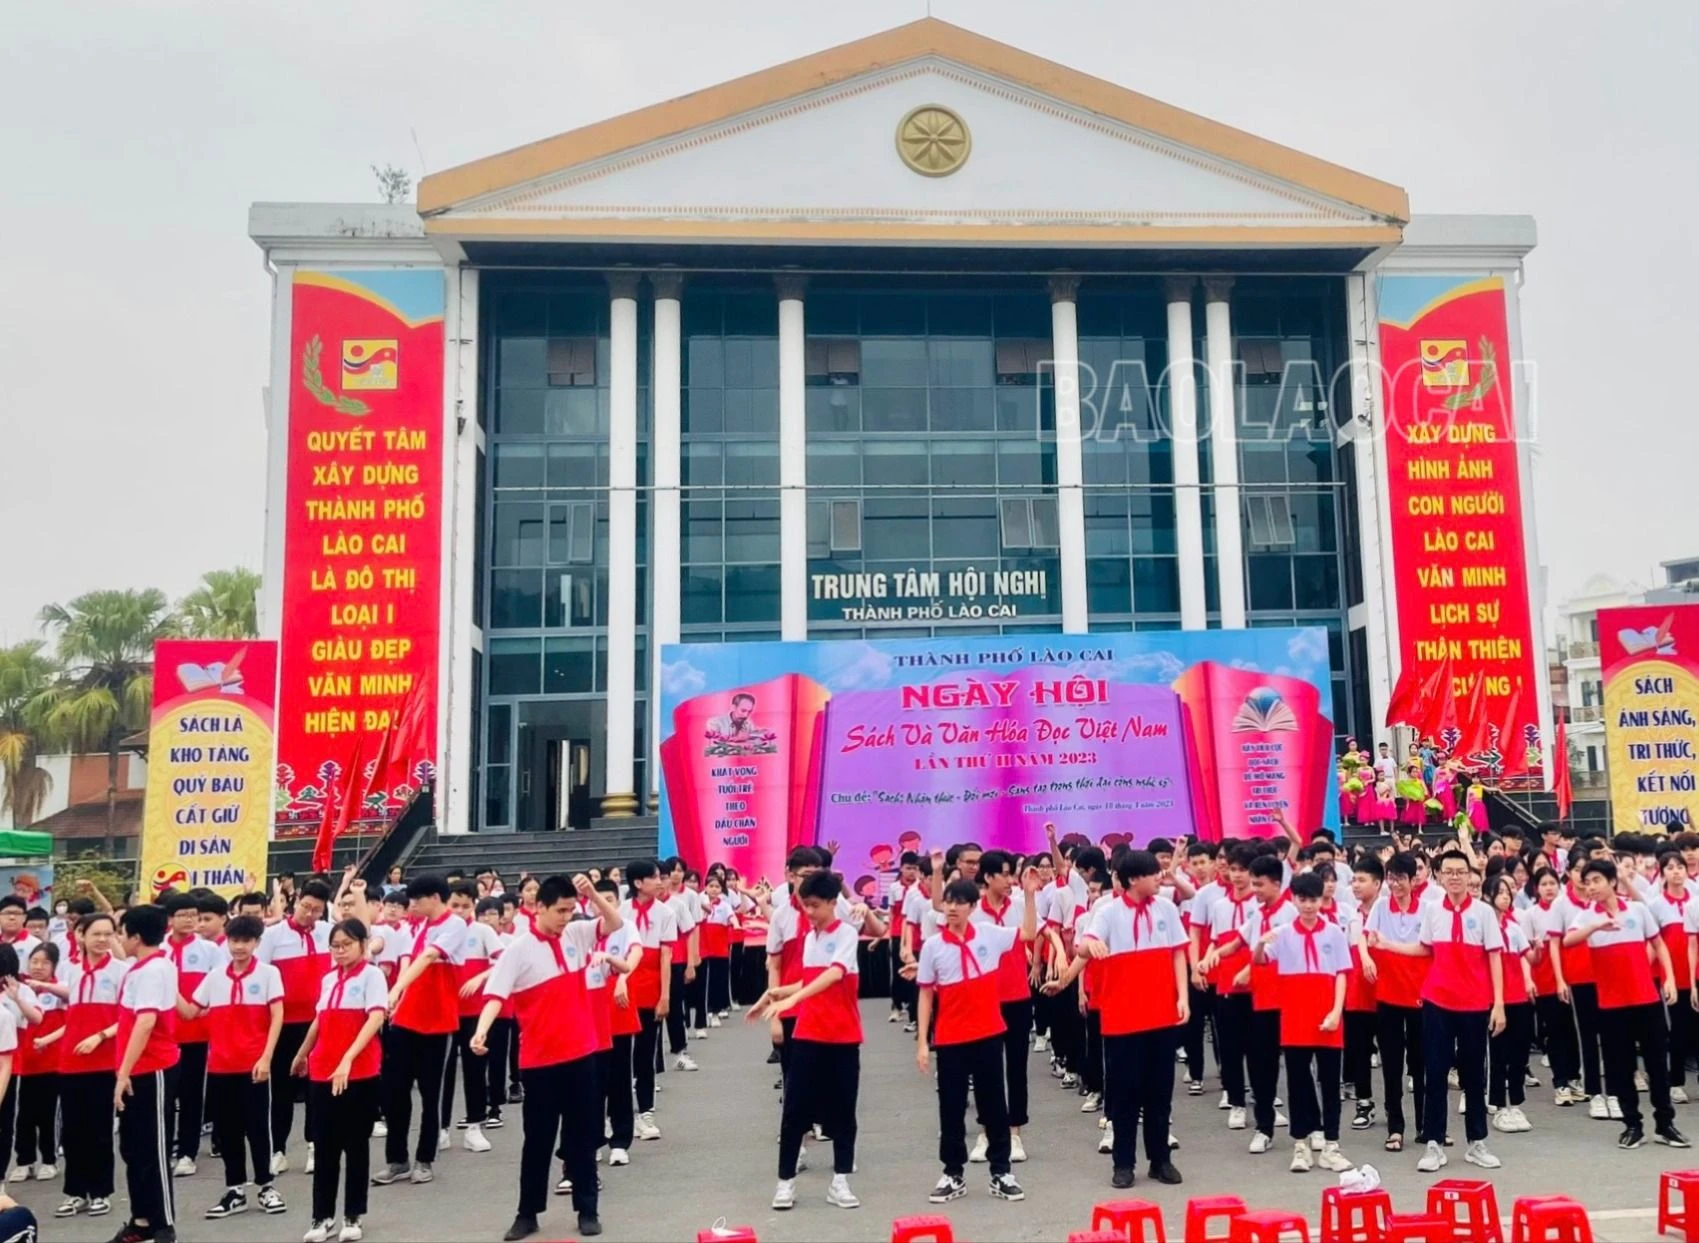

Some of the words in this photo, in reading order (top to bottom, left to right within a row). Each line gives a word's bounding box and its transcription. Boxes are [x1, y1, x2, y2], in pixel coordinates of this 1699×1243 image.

[307, 425, 376, 452] QUYẾT
[383, 426, 427, 450] TÂM
[1407, 421, 1441, 444] XÂY
[1448, 421, 1497, 449] DỰNG
[313, 461, 355, 486] XÂY
[363, 461, 419, 491] DỰNG
[1408, 456, 1450, 480] HÌNH
[1457, 453, 1494, 479] ẢNH
[306, 495, 375, 521] THÀNH
[383, 492, 425, 519] PHỐ
[1408, 495, 1445, 516] CON
[1451, 490, 1505, 515] NGƯỜI
[322, 530, 363, 555] LÀO
[371, 534, 406, 554] CAI
[1424, 526, 1459, 552] LÀO
[1465, 530, 1495, 551] CAI
[311, 565, 337, 591] LÀ
[345, 564, 374, 590] ĐÔ
[382, 568, 415, 595] THỊ
[812, 573, 887, 599] TRUNG
[893, 568, 940, 598] TÂM
[949, 567, 986, 601] HỘI
[994, 570, 1046, 599] NGHỊ
[1417, 563, 1454, 588] VĂN
[1462, 566, 1506, 588] MINH
[331, 603, 378, 631] LOẠI
[387, 603, 394, 625] I
[842, 604, 902, 621] THÀNH
[907, 599, 944, 619] PHỐ
[949, 602, 982, 618] LÀO
[988, 604, 1016, 617] CAI
[1430, 603, 1470, 629] LỊCH
[1476, 598, 1500, 628] SỰ
[312, 635, 362, 661] GIÀU
[371, 639, 411, 665] ĐẸP
[894, 651, 969, 667] THÀNH
[979, 647, 1024, 664] PHỐ
[1030, 647, 1073, 662] LÀO
[1080, 649, 1114, 661] CAI
[1416, 636, 1462, 661] THÂN
[1467, 634, 1521, 665] THIỆN
[308, 672, 351, 697] VĂN
[360, 673, 412, 696] MINH
[902, 678, 1019, 710] NGÀY
[1030, 675, 1109, 707] HỘI
[1635, 675, 1673, 694] SÁCH
[179, 713, 220, 733] SÁCH
[224, 713, 243, 733] LÀ
[305, 707, 356, 739] HIỆN
[1618, 708, 1649, 727] ÁNH
[1653, 708, 1696, 728] SÁNG,
[841, 724, 895, 752] Sách
[901, 722, 932, 746] Và
[938, 722, 979, 744] Văn
[984, 719, 1027, 743] Hóa
[1033, 718, 1070, 745] Đọc
[1075, 717, 1117, 743] Việt
[1121, 716, 1168, 743] Nam
[170, 747, 203, 763] KHO
[208, 744, 250, 762] TÀNG
[914, 752, 950, 770] LẦN
[954, 753, 991, 769] THỨ
[1011, 752, 1054, 767] NĂM
[1059, 752, 1097, 765] 2023
[1628, 743, 1651, 760] TRI
[1655, 739, 1696, 760] THỨC,
[173, 774, 207, 796] QUÝ
[212, 774, 244, 793] BÁU
[1637, 770, 1665, 792] KẾT
[1669, 769, 1696, 792] NỐI
[176, 802, 207, 824] CẤT
[212, 804, 240, 823] GIỮ
[179, 839, 195, 855] DI
[200, 835, 231, 855] SẢN
